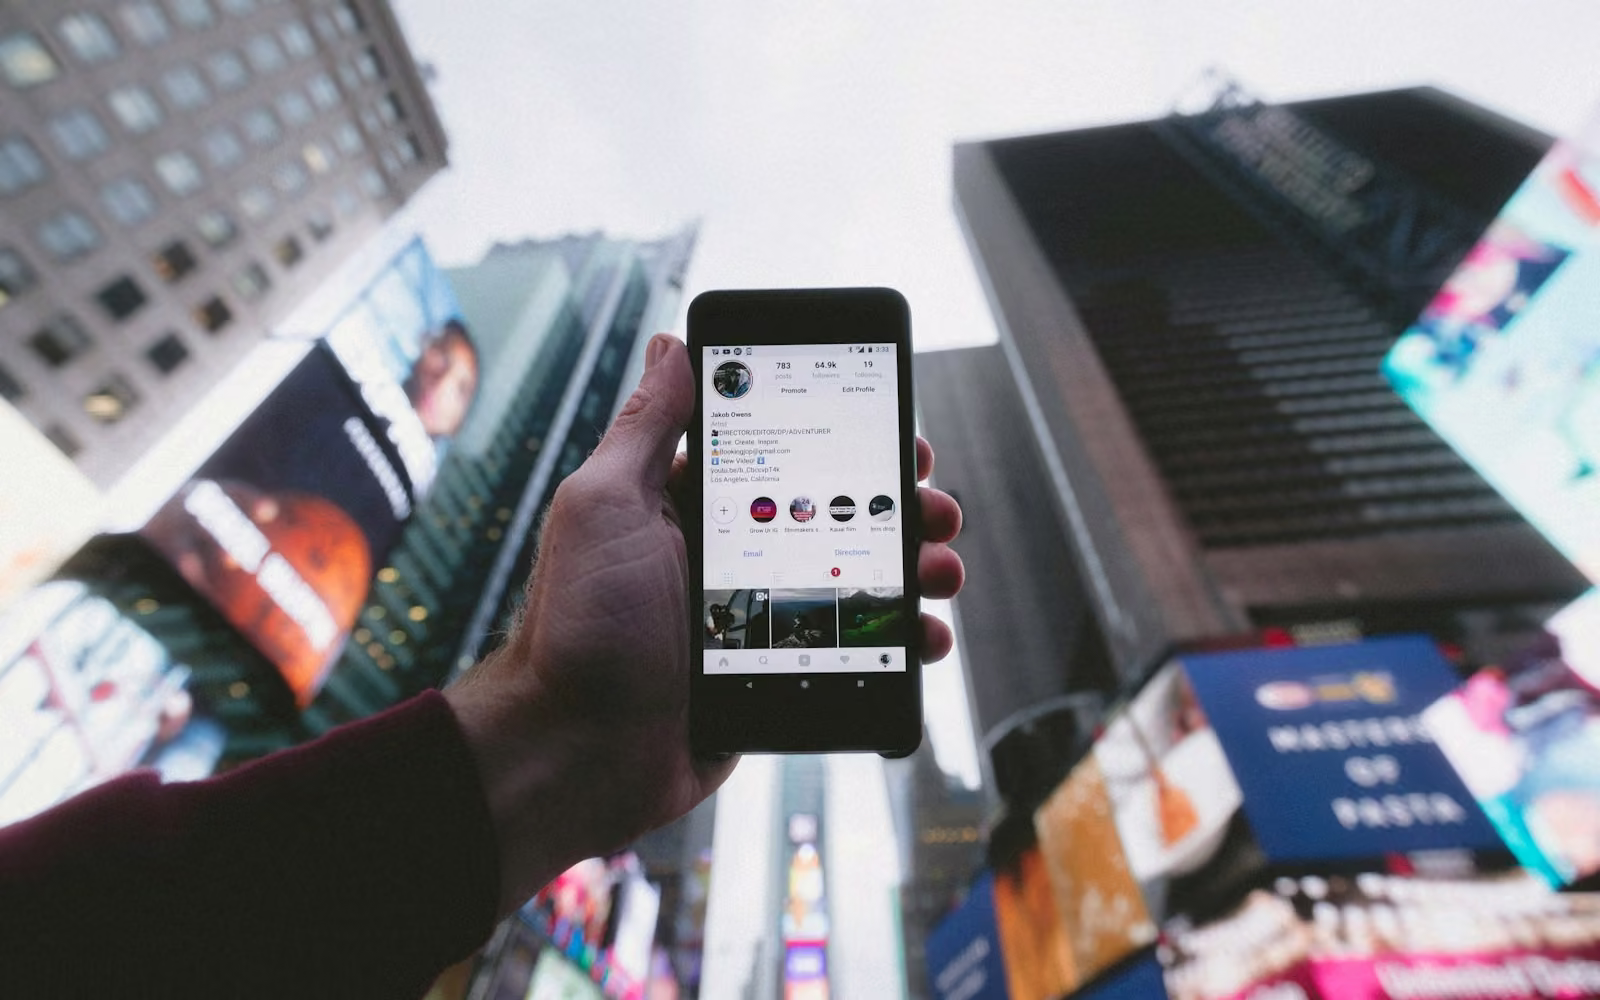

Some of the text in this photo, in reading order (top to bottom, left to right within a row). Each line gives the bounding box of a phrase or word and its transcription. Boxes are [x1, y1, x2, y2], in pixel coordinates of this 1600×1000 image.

[775, 361, 791, 370] 783
[814, 360, 837, 369] 64.9k
[863, 360, 873, 368] 19
[775, 372, 792, 381] posts
[812, 371, 840, 379] followers
[710, 475, 724, 483] Los
[750, 475, 780, 483] California
[743, 550, 763, 558] Email
[834, 548, 871, 557] Directions
